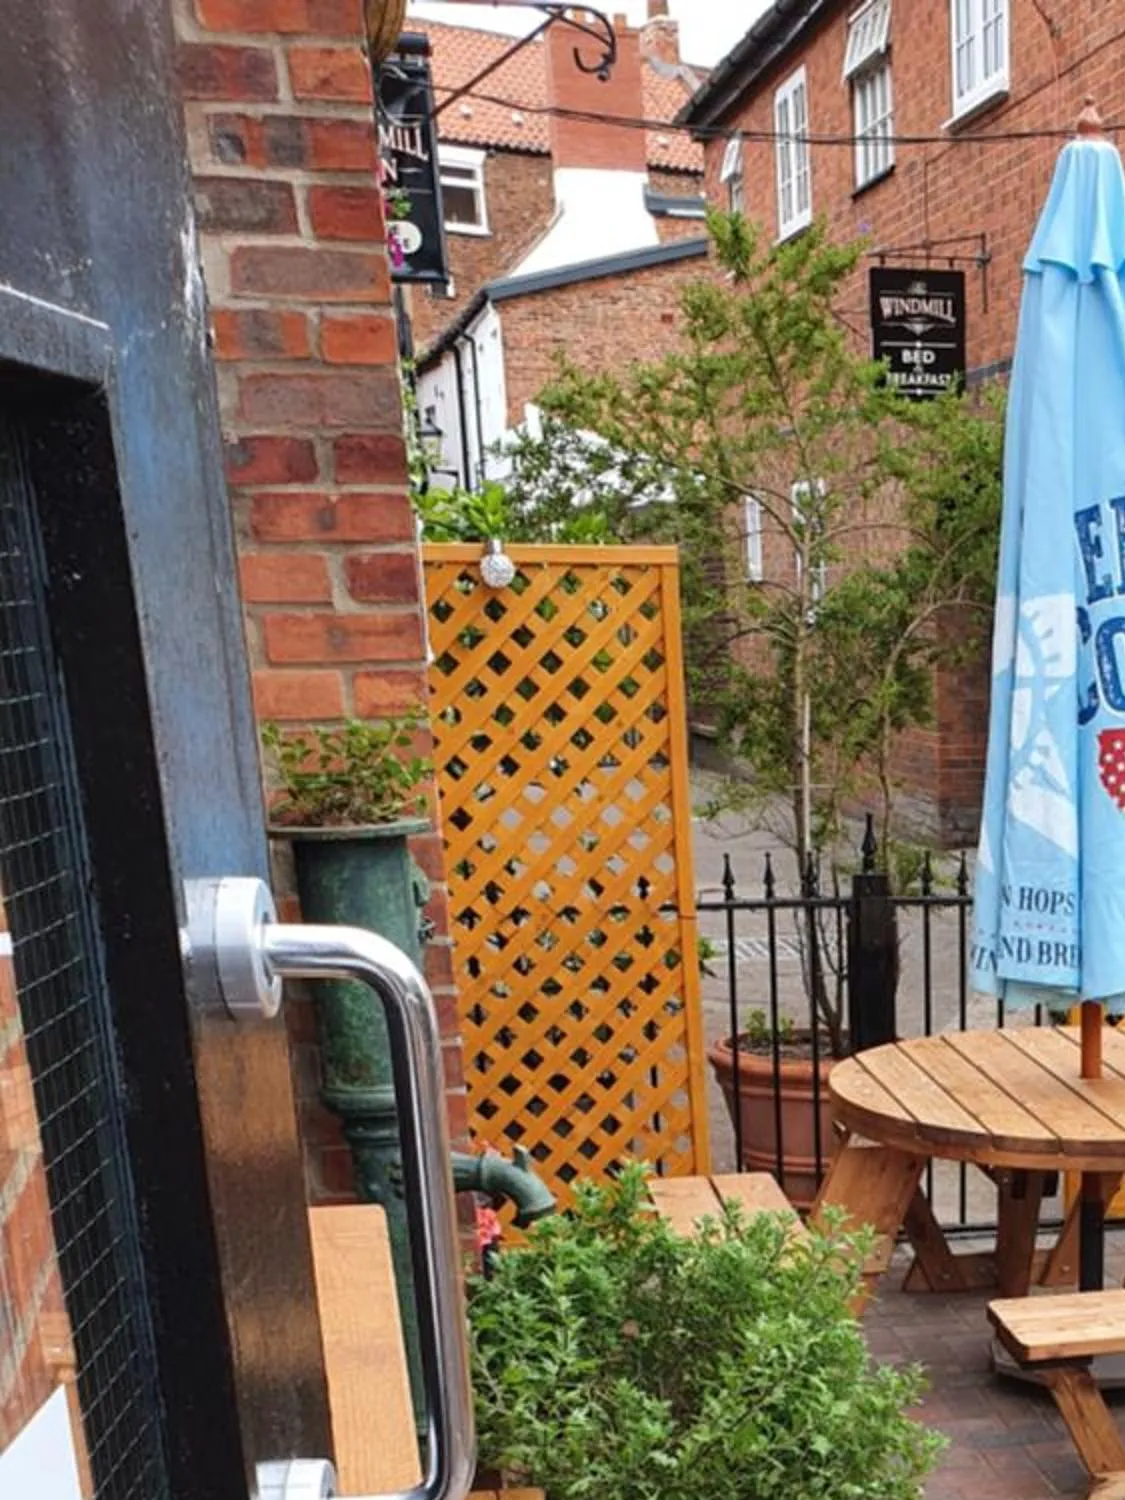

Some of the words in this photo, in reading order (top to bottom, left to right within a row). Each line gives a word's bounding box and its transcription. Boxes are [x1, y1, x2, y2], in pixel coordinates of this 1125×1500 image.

[879, 297, 957, 323] WINDMILL
[901, 350, 936, 365] BED
[1019, 885, 1076, 917] HOPS
